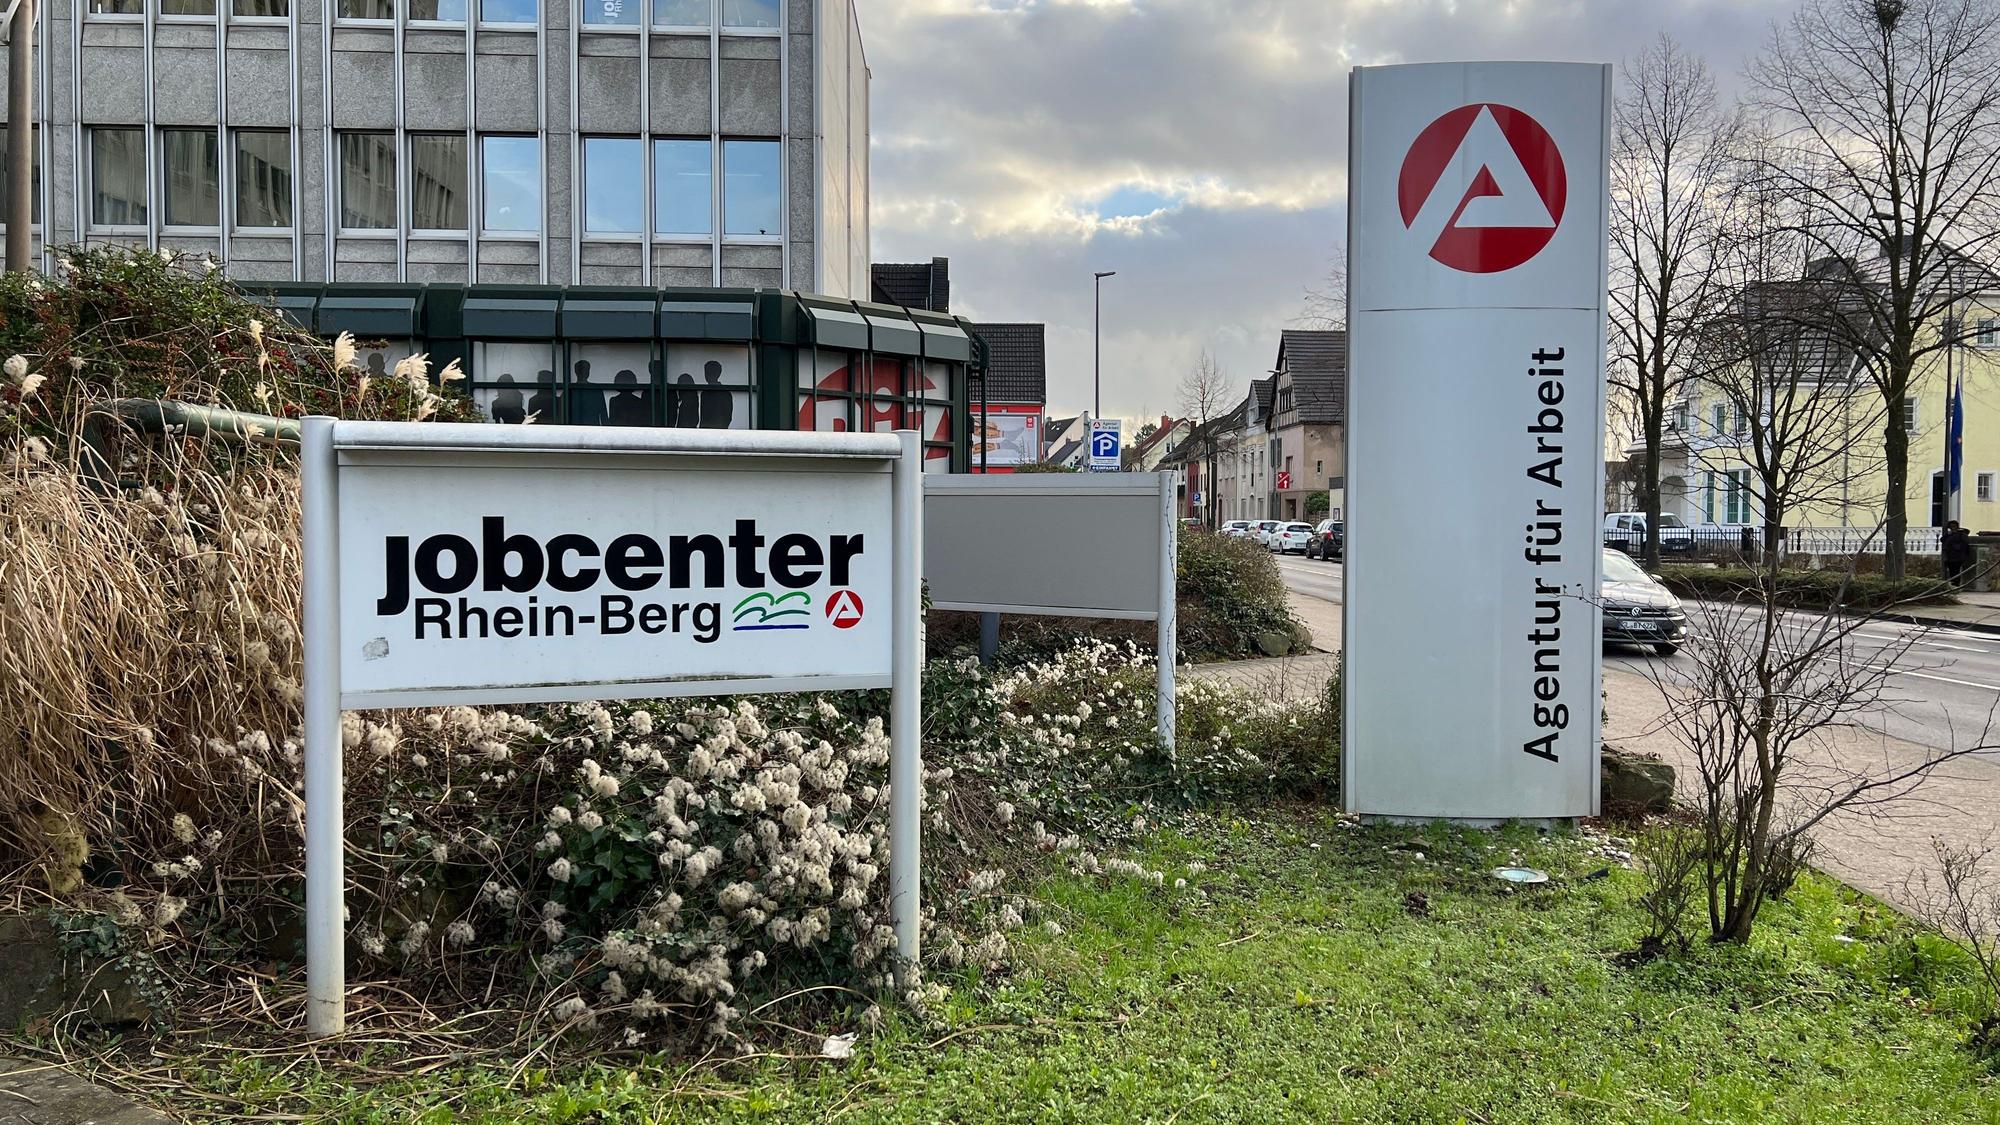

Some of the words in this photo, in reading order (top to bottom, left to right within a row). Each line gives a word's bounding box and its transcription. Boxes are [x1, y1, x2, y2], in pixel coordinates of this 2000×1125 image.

[1100, 439, 1113, 455] P
[1526, 347, 1565, 488] Arbeit
[377, 516, 864, 616] jobcenter
[1524, 499, 1562, 565] für
[415, 594, 721, 644] Rhein-Berg
[1524, 577, 1569, 762] Agentur
